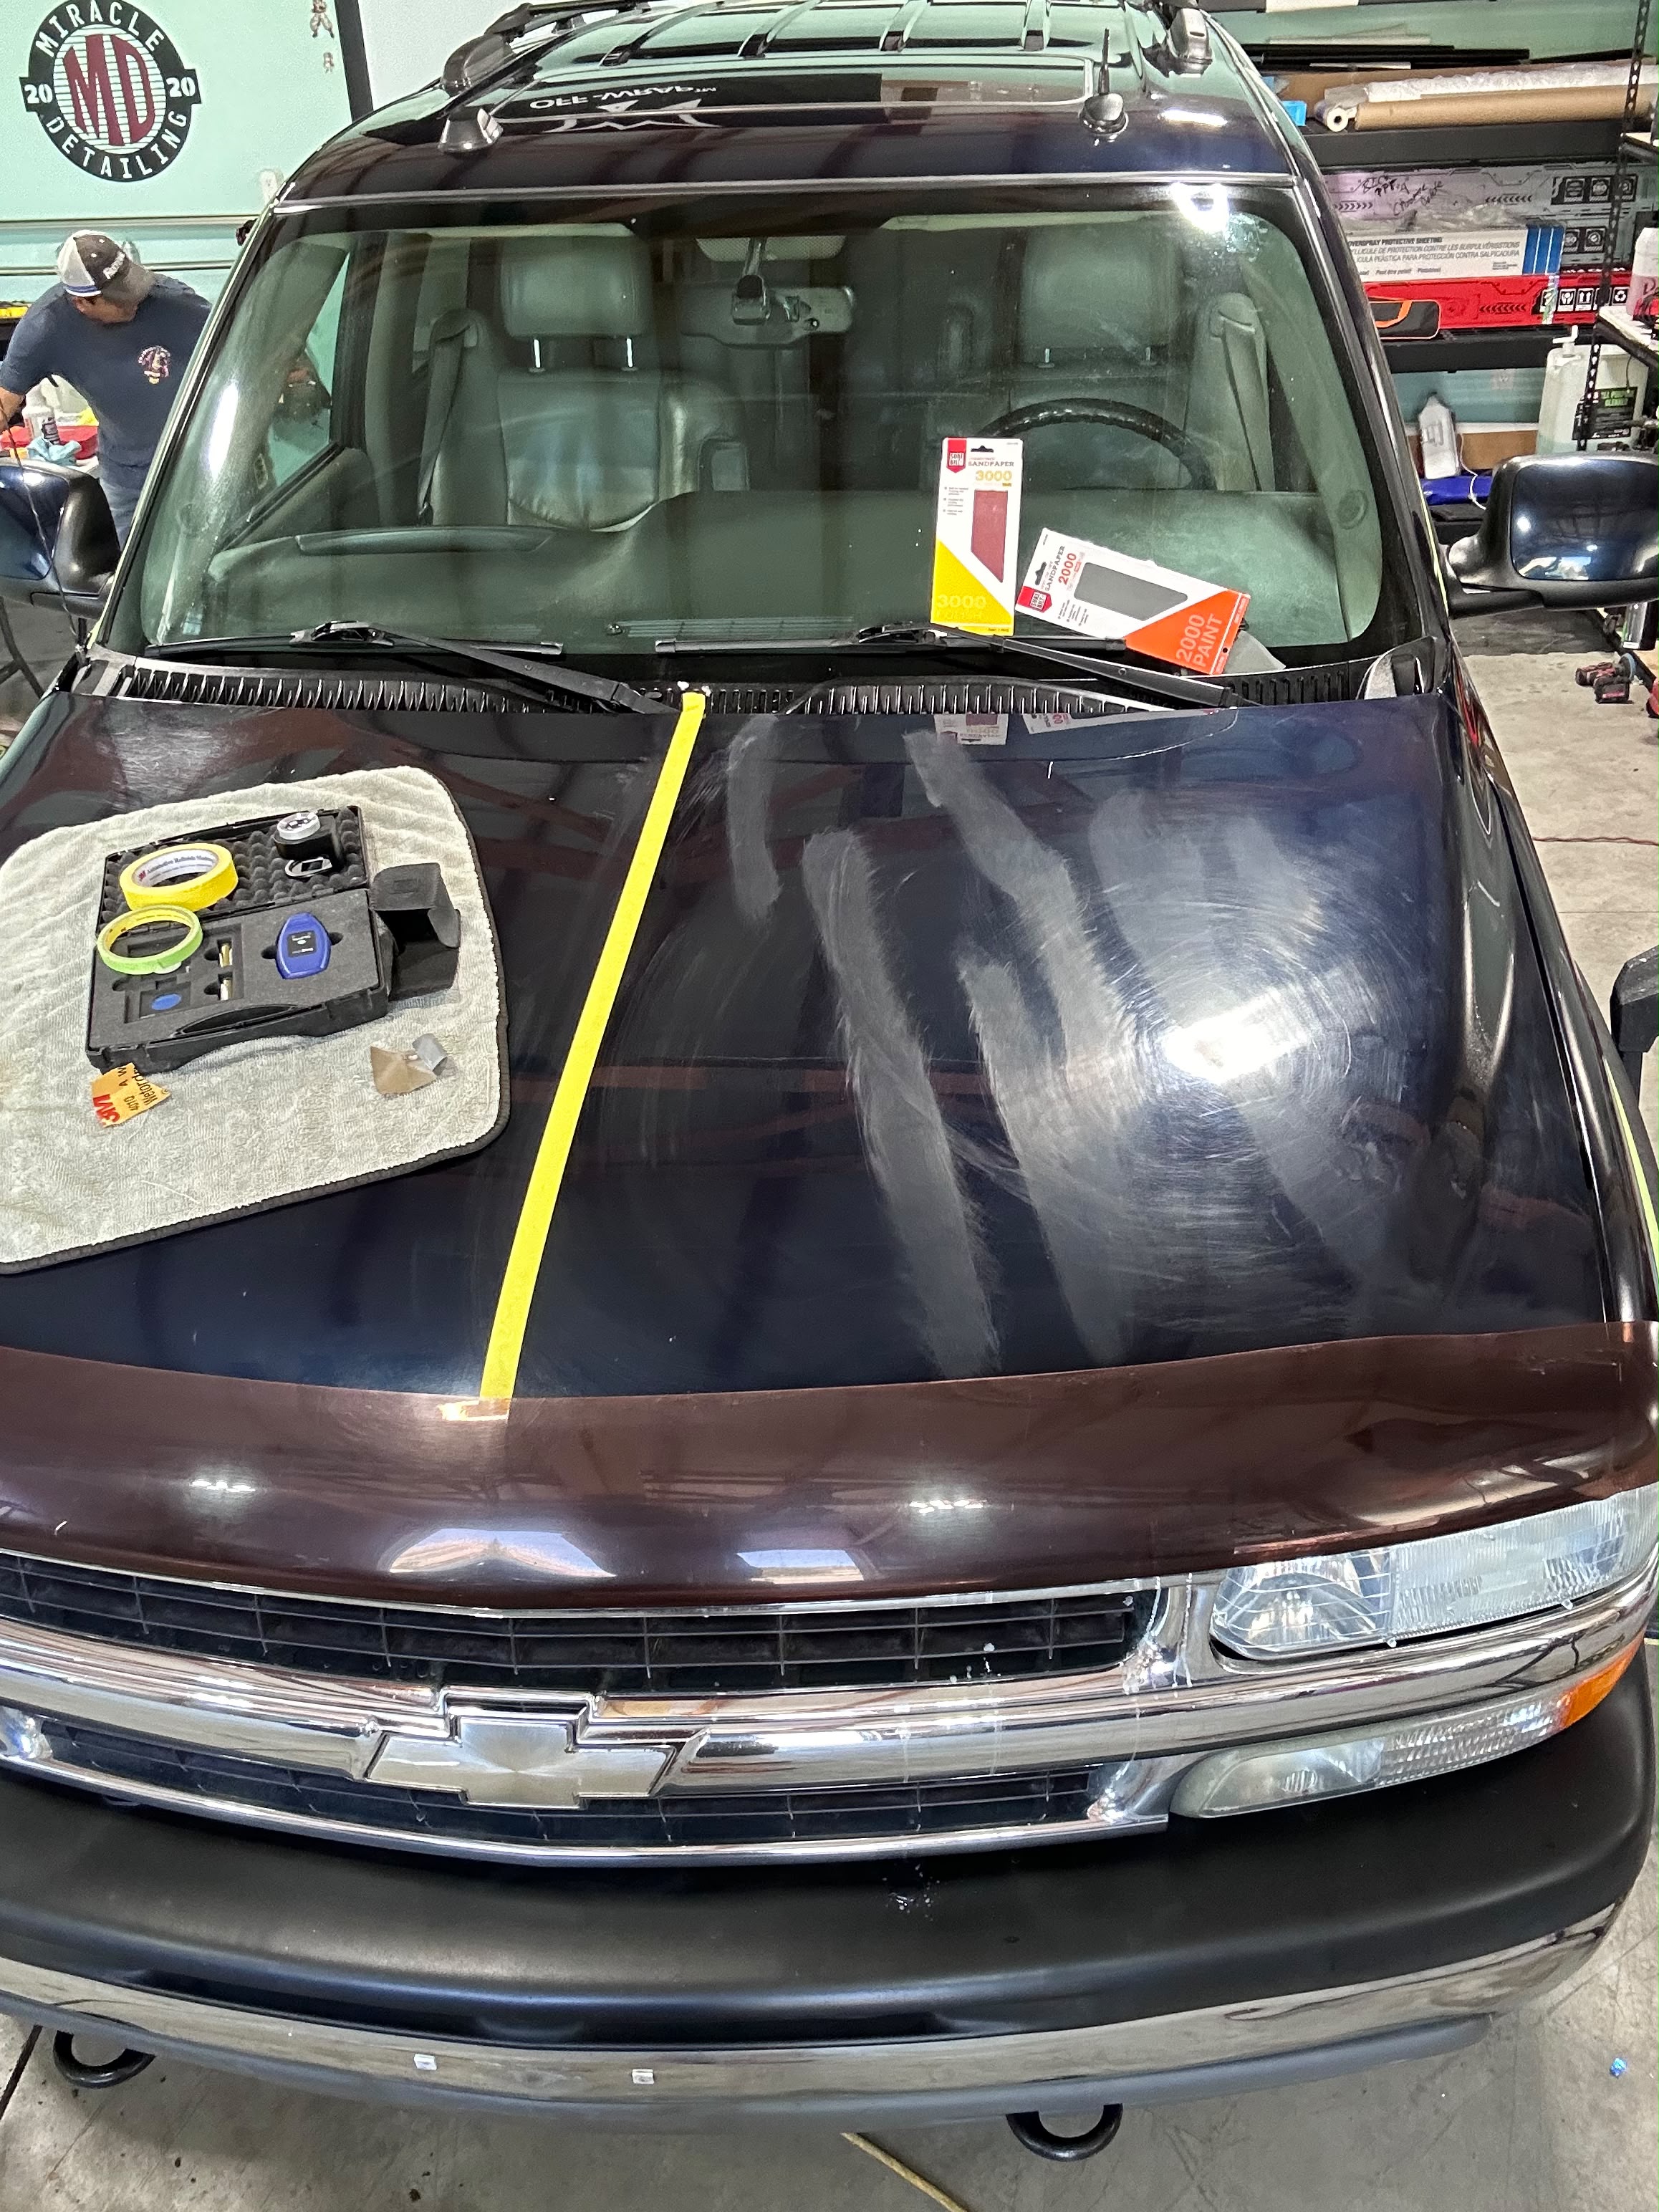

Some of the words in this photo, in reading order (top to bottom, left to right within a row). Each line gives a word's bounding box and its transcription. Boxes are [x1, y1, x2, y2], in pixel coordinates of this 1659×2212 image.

[36, 0, 165, 58] MIRACLE
[24, 83, 53, 104] 20
[62, 34, 155, 147] MD
[165, 77, 196, 97] 20
[46, 110, 187, 178] DETAILING
[976, 470, 1012, 481] 3000
[1045, 545, 1065, 591] SANDPAPER
[1058, 553, 1077, 585] 2000
[937, 594, 986, 609] 3000
[1175, 614, 1205, 663] 2000
[1193, 613, 1223, 668] PAINT
[93, 1093, 120, 1123] 3M
